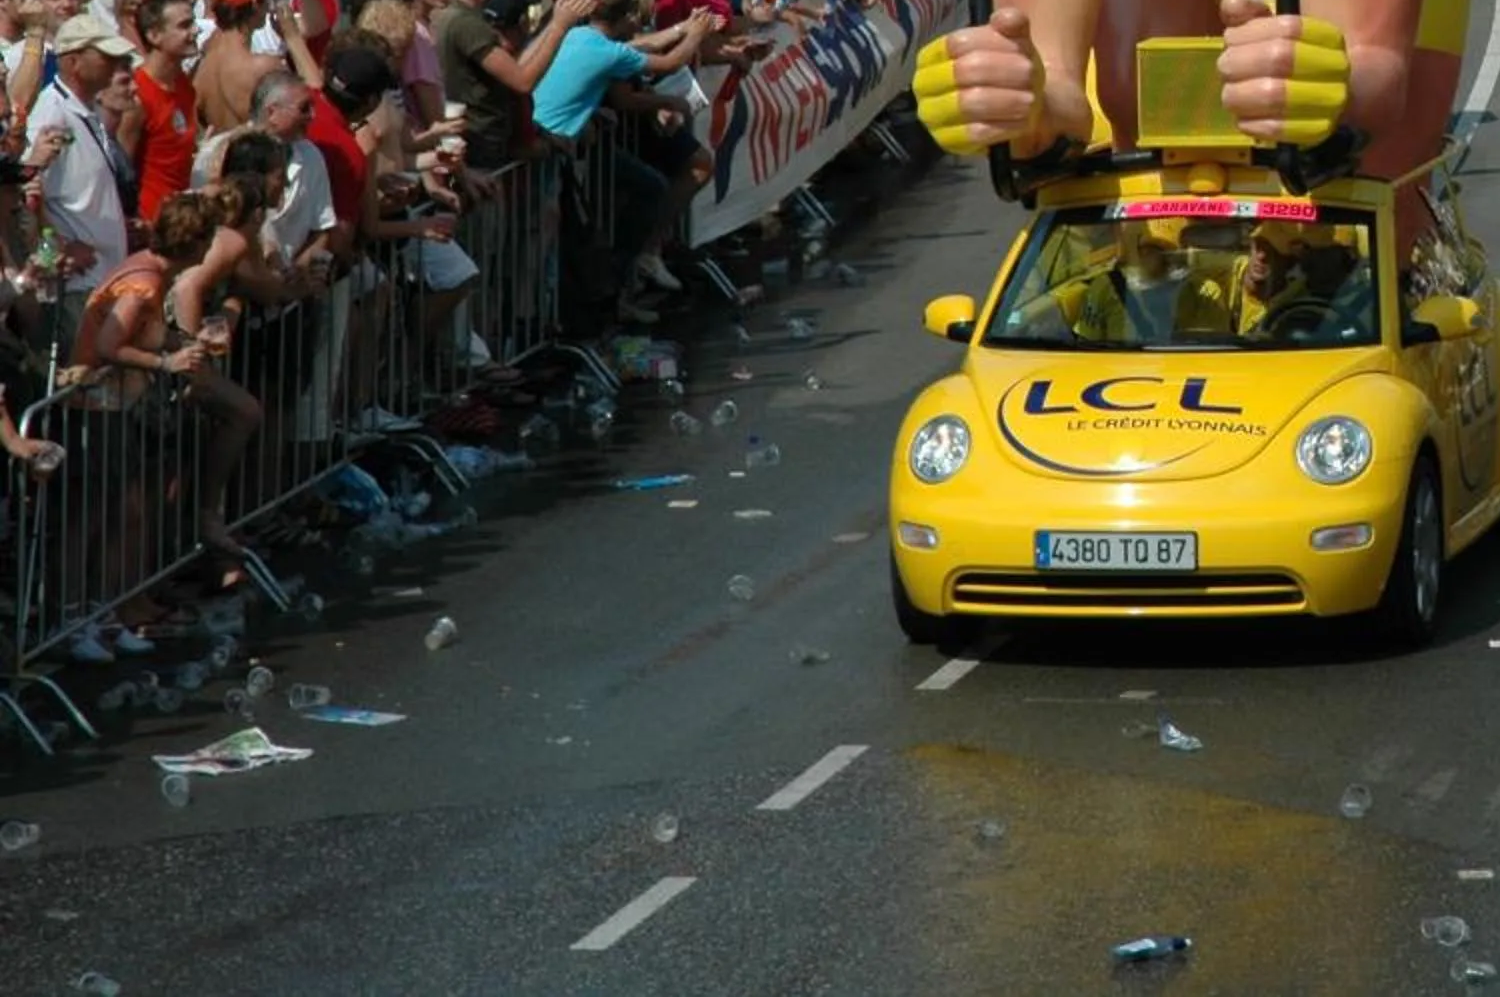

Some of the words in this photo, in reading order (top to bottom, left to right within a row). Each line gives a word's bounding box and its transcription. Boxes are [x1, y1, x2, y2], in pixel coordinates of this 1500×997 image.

[1024, 376, 1243, 415] LCL
[1067, 421, 1088, 431] LE
[1092, 415, 1164, 430] CRÉDIT
[1167, 419, 1267, 436] LYONNAIS
[1051, 538, 1111, 564] 4380
[1156, 538, 1187, 564] 87
